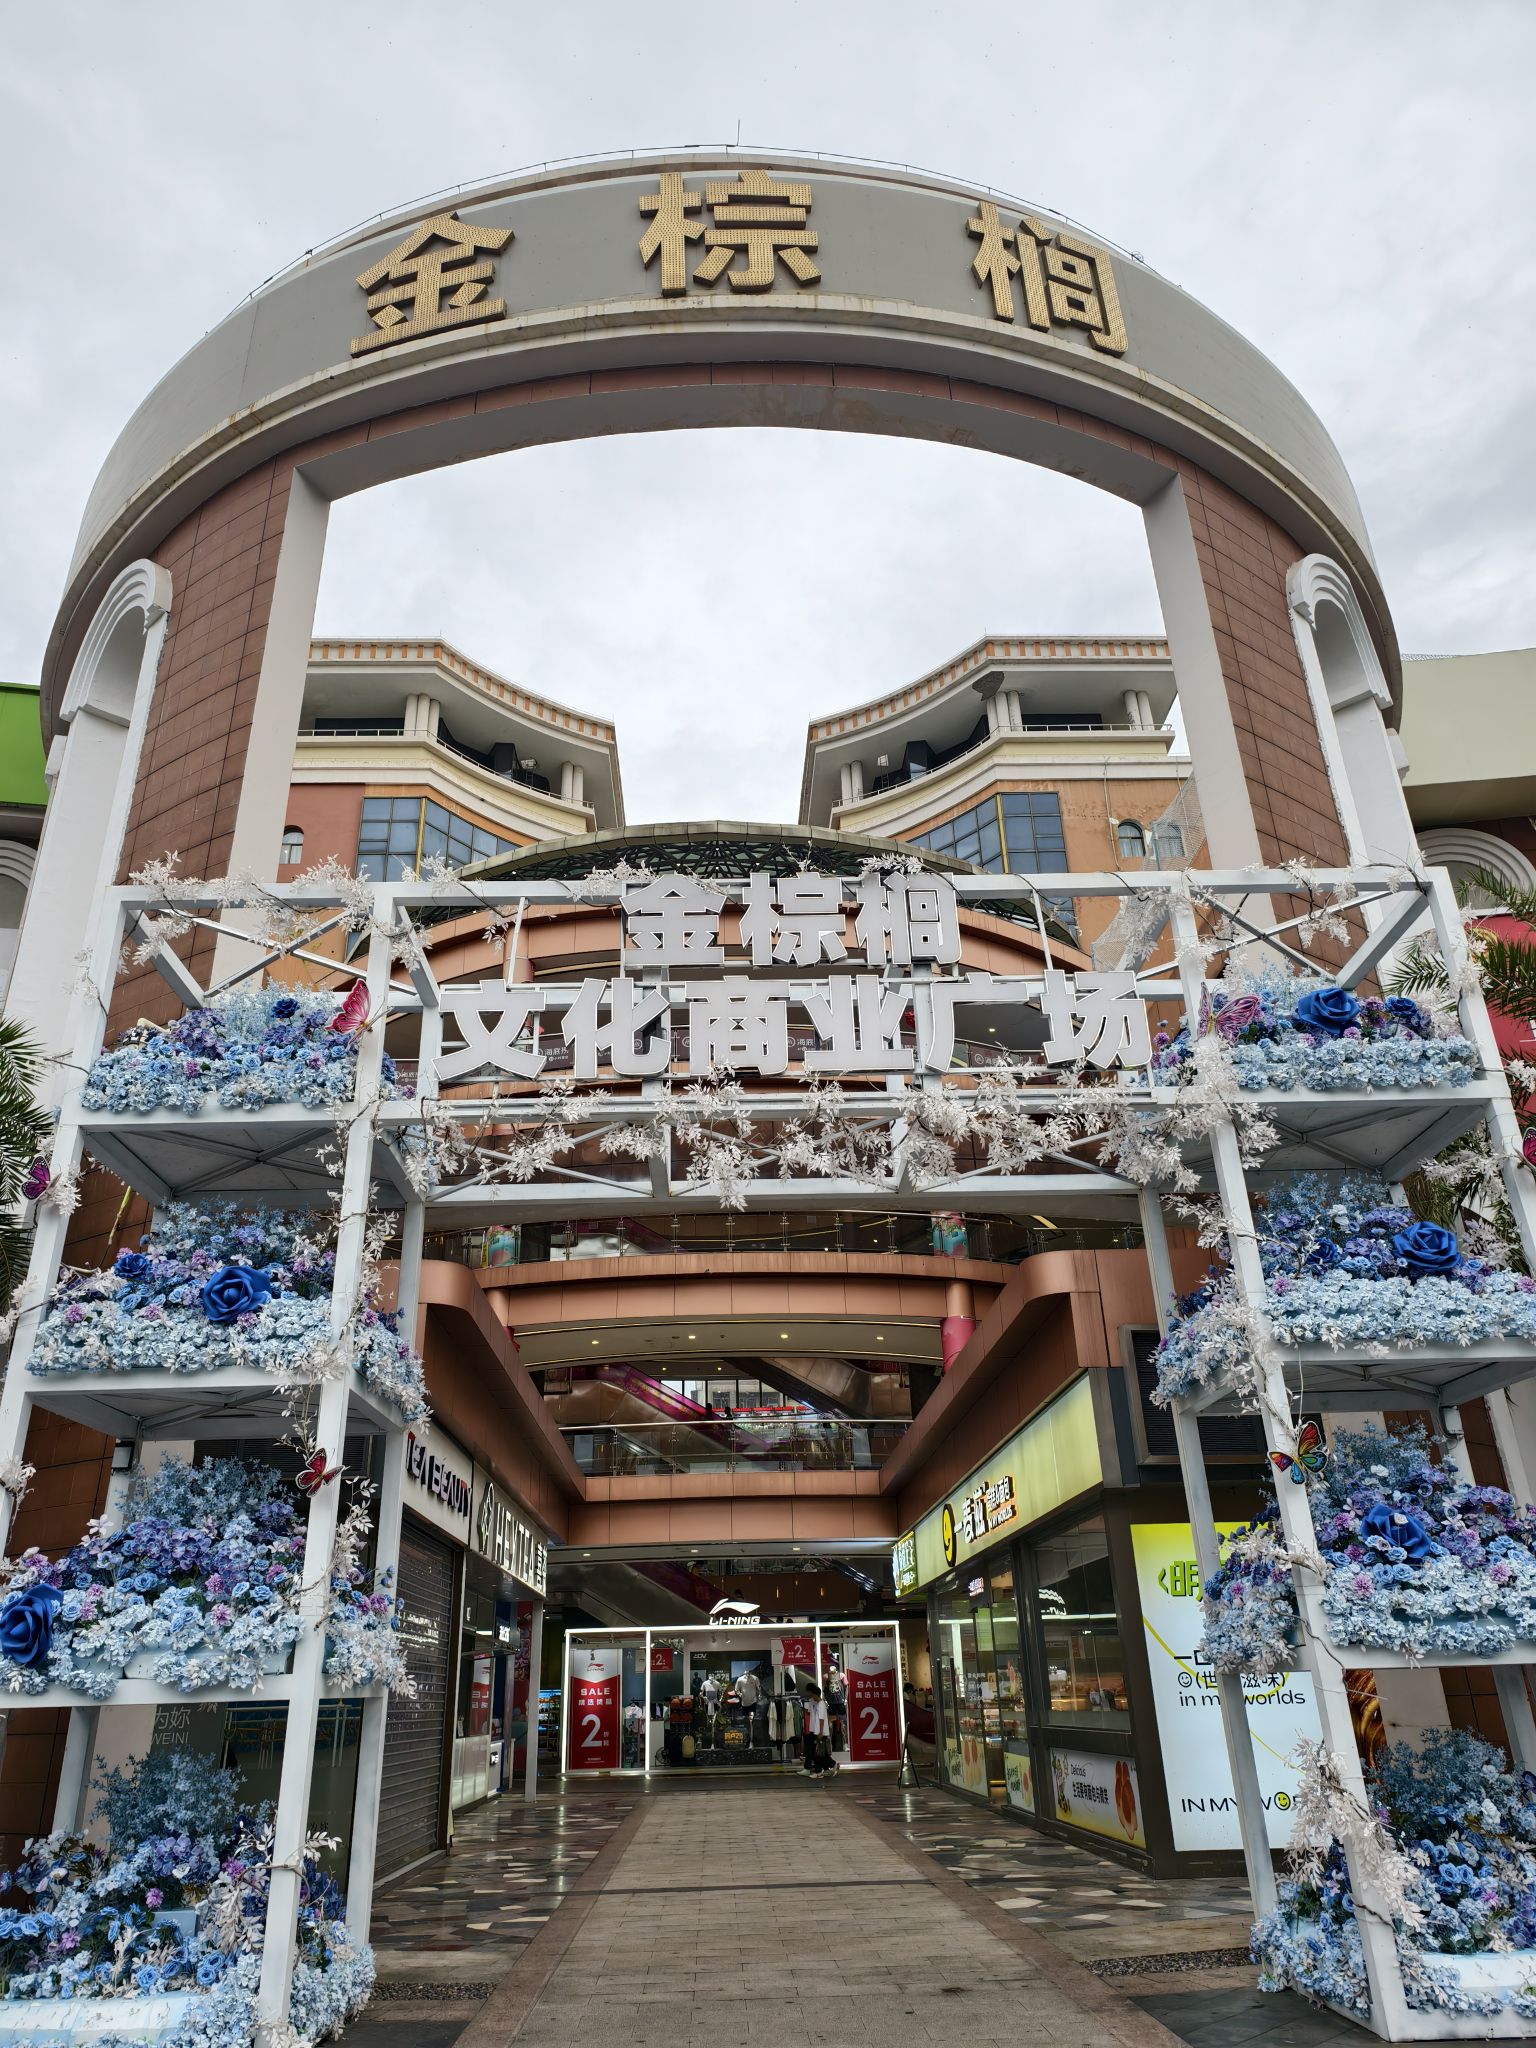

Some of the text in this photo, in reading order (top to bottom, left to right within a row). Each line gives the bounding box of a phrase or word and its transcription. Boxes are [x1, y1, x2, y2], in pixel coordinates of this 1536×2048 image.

[350, 169, 1129, 358] 金棕榈
[620, 872, 962, 967] 金棕榈
[431, 969, 1153, 1081] 文化商业广场
[406, 1431, 426, 1485] TEA
[494, 1502, 535, 1586] HEYTEA
[709, 1616, 760, 1626] LI-NING
[580, 1687, 610, 1696] SALE
[857, 1680, 886, 1689] SALE
[1179, 1691, 1197, 1707] in
[581, 1713, 603, 1748] 2
[860, 1706, 882, 1740] 2
[1181, 1798, 1206, 1813] IN
